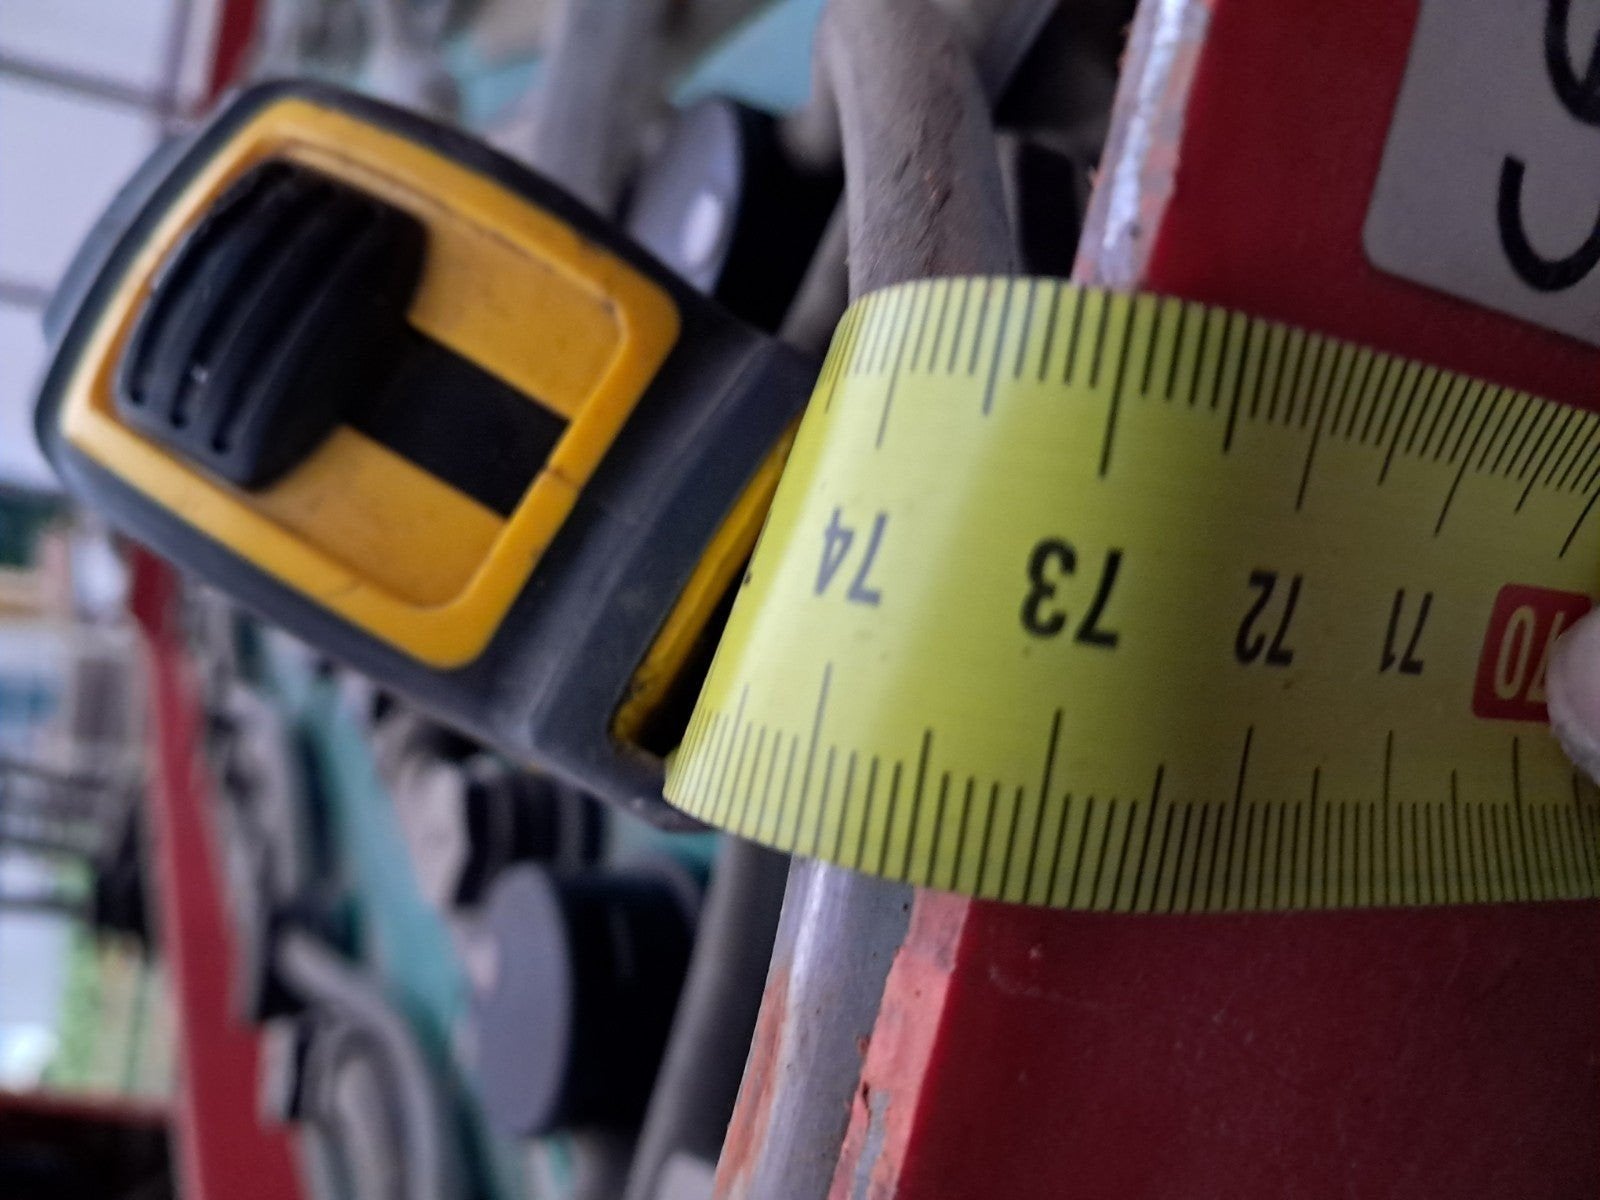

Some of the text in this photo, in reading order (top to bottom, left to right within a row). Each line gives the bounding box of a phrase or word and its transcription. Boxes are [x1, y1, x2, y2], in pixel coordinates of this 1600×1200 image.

[814, 507, 889, 606] 74
[1021, 536, 1124, 649] 73
[1235, 570, 1303, 667] 72
[1379, 587, 1434, 676] 71
